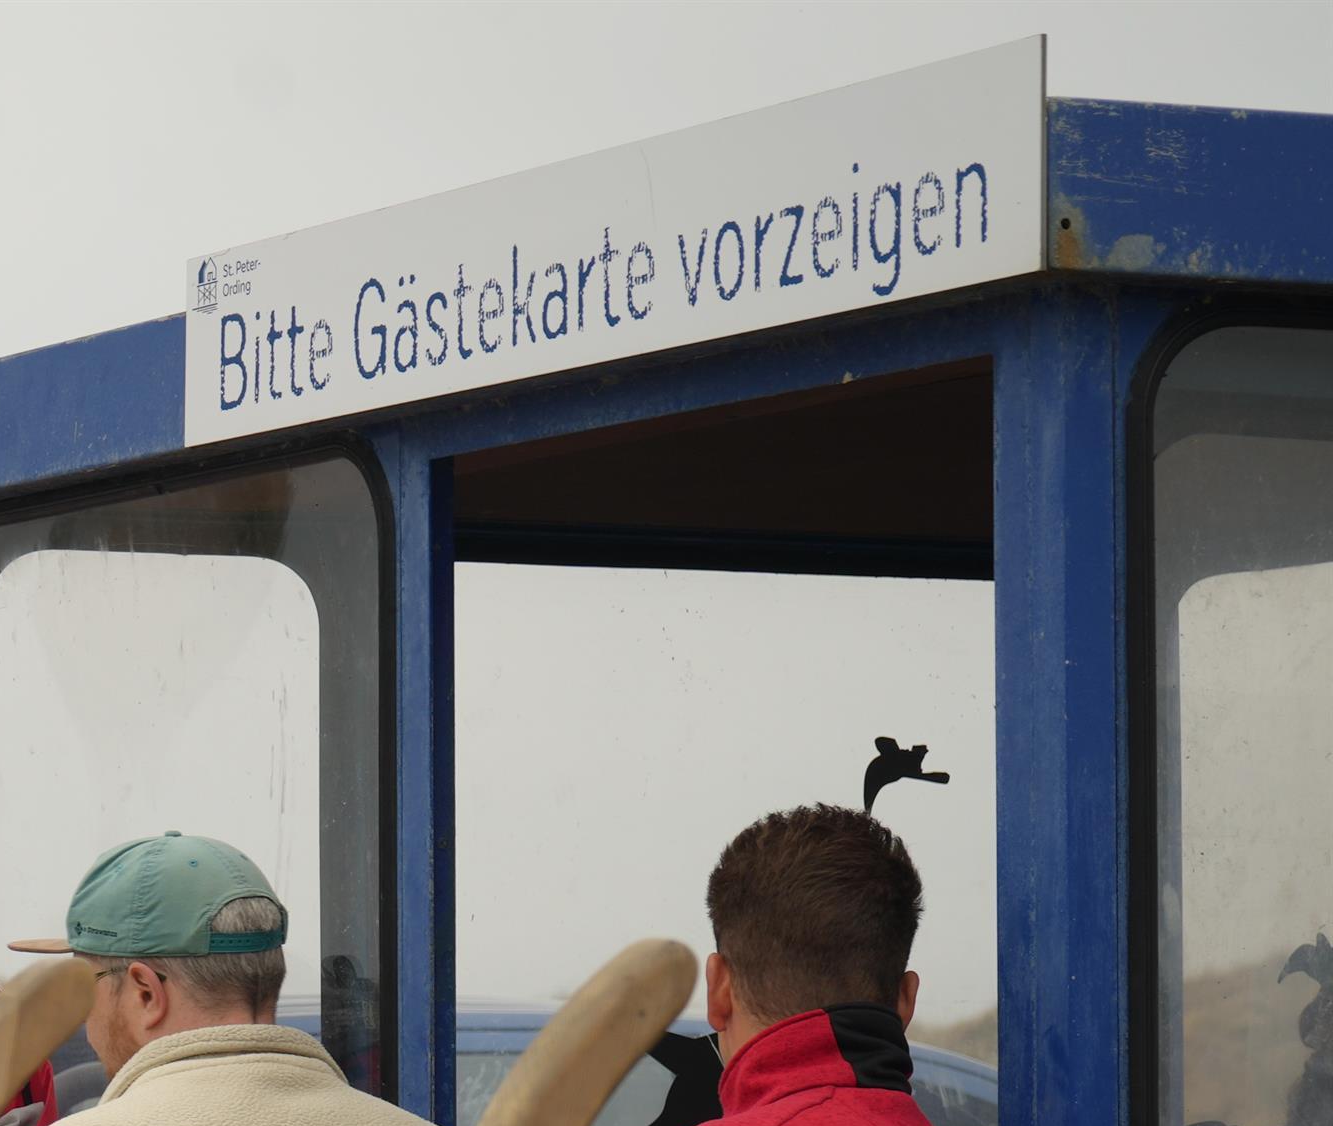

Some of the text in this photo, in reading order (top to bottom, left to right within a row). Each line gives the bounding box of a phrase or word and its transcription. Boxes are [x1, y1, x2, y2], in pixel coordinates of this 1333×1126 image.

[222, 259, 261, 278] St. Peter-
[220, 162, 988, 411] Bitte Gästekarte vorzeigen
[222, 280, 251, 297] Ording
